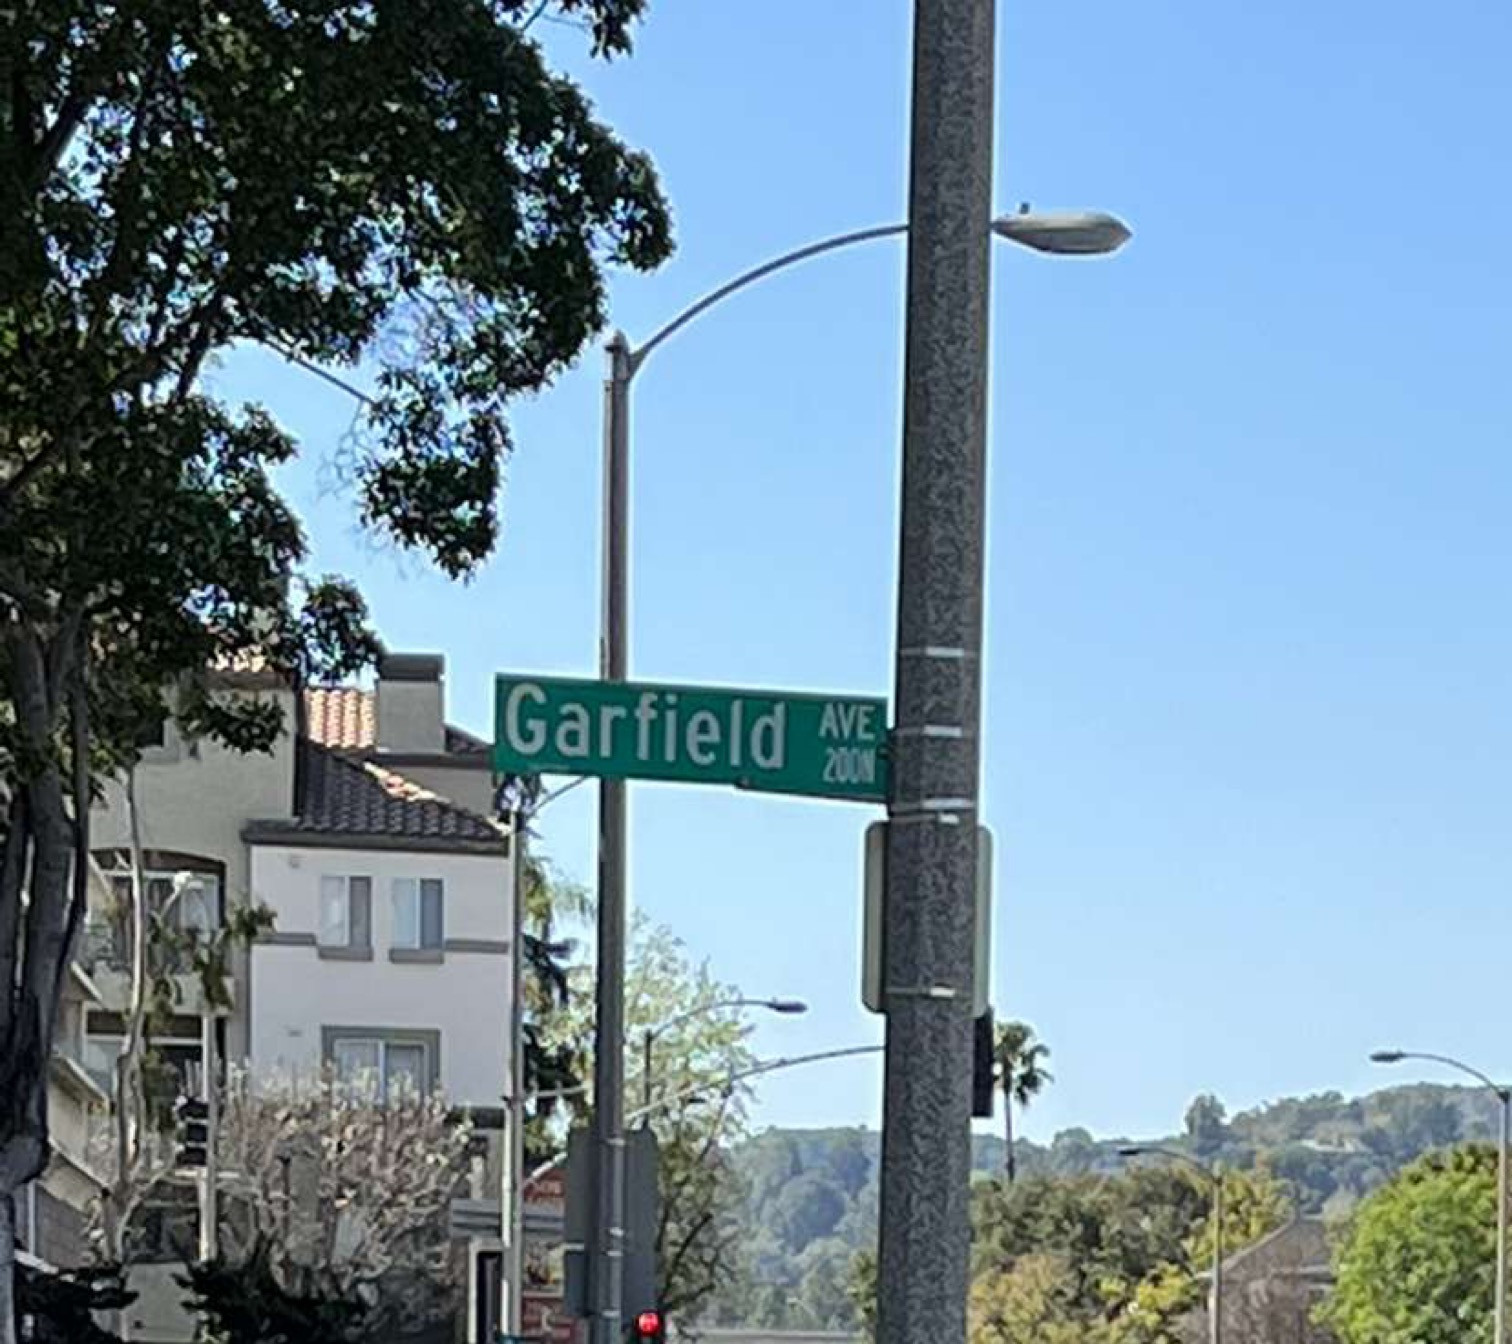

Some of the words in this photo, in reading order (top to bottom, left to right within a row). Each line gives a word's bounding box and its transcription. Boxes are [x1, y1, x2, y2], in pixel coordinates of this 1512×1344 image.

[505, 682, 786, 769] Garfield
[818, 702, 876, 740] AVE
[822, 747, 876, 784] 200N
